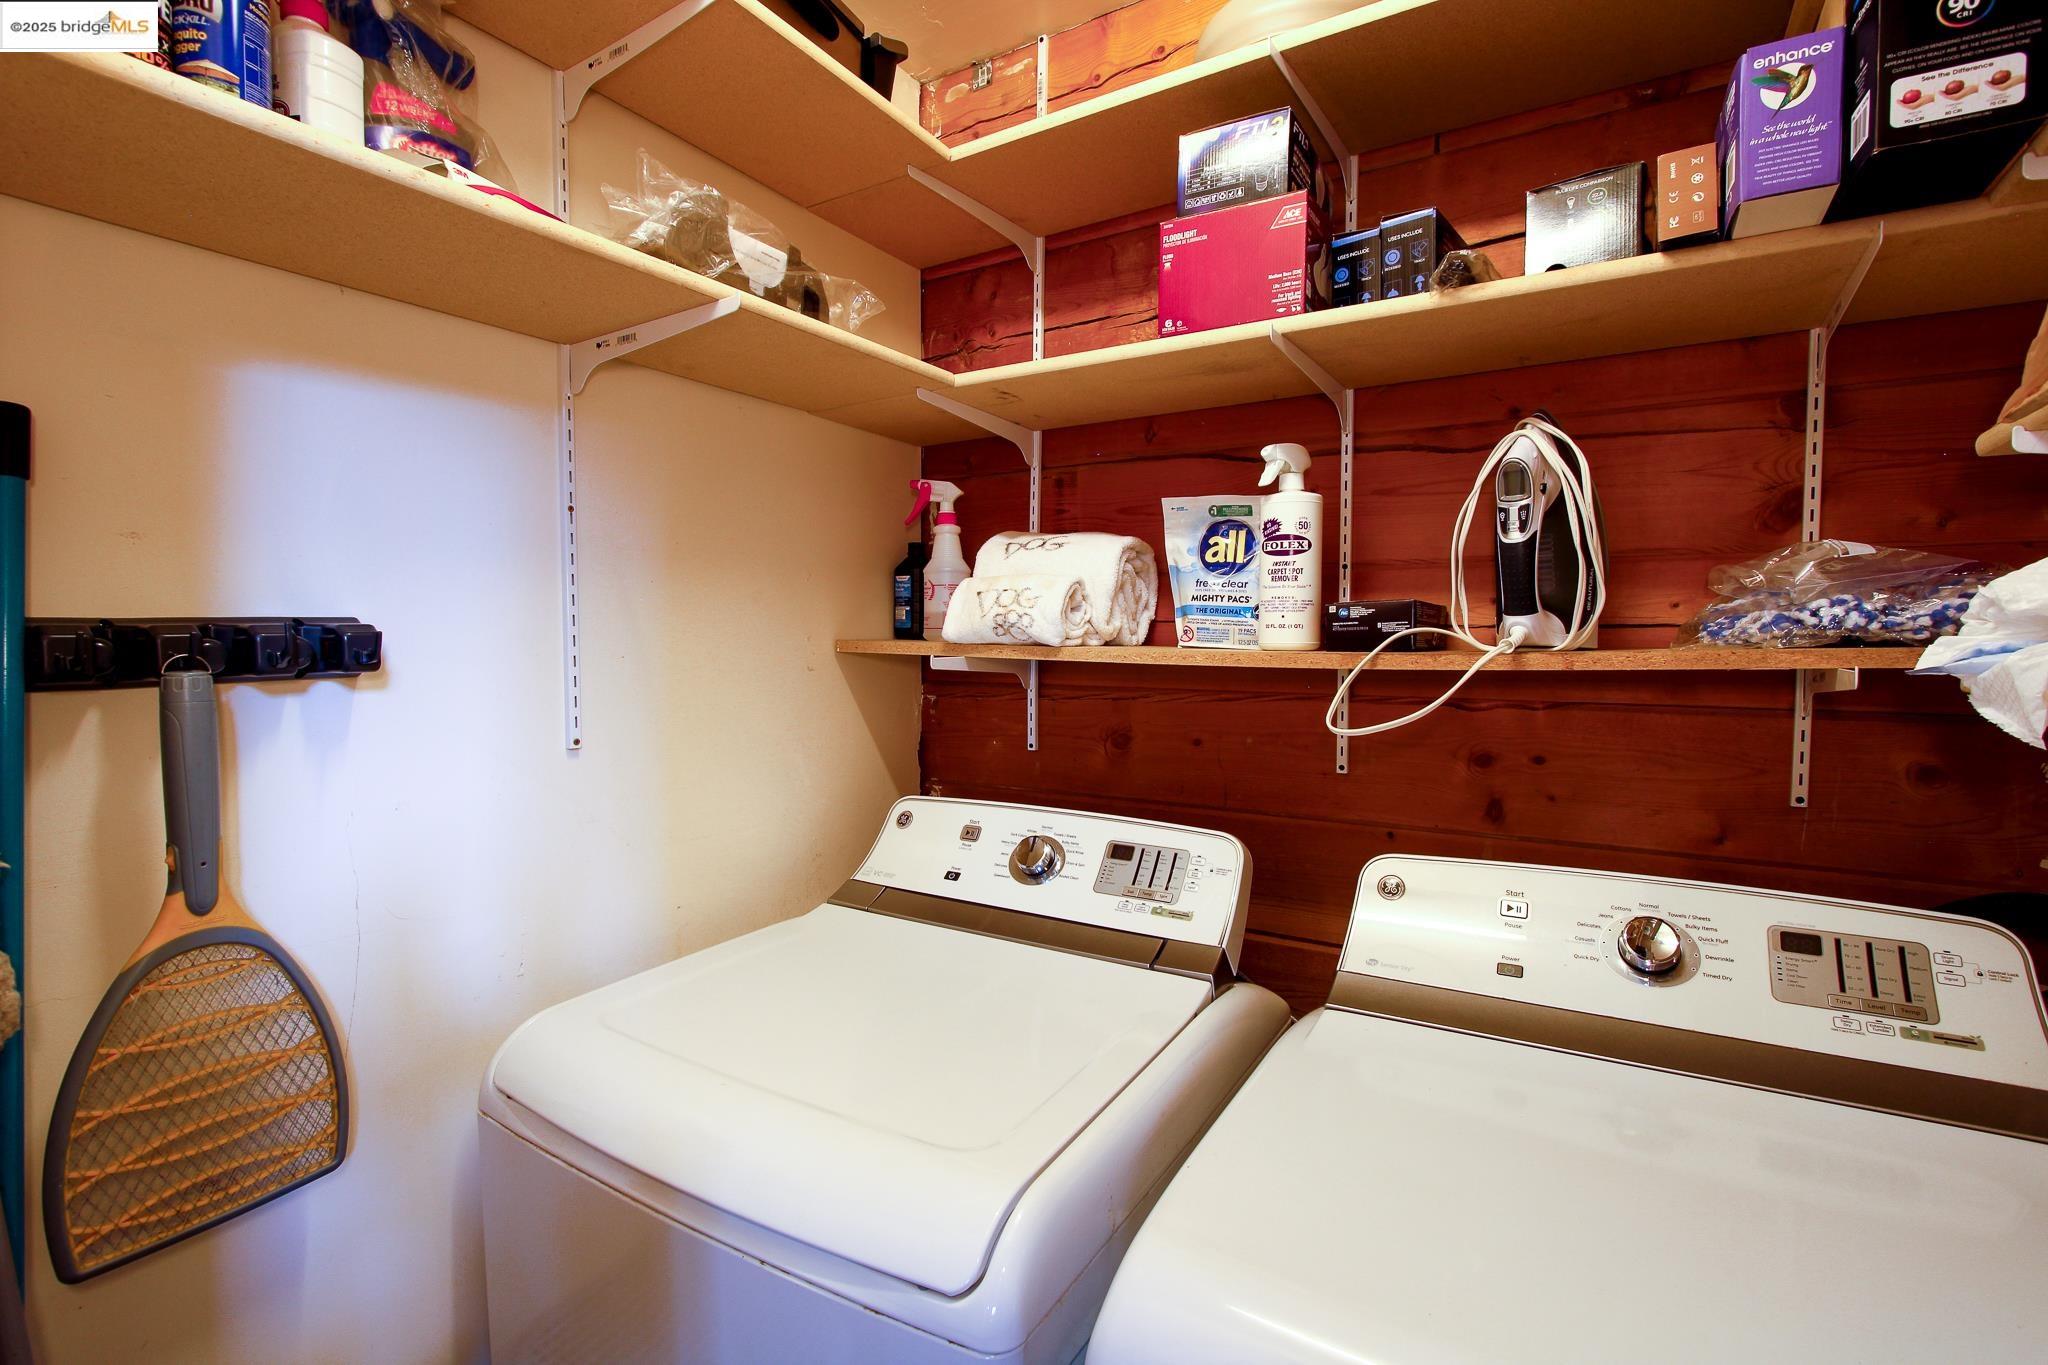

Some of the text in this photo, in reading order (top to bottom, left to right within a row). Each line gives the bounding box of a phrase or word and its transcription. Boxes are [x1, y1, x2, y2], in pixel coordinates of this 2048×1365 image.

[1956, 10, 1973, 18] CRI
[1753, 41, 1834, 70] enhance
[1937, 70, 1951, 78] the
[1952, 61, 1994, 76] Difference
[1762, 114, 1816, 134] See the world
[1765, 130, 1789, 142] whole
[1790, 129, 1807, 137] new
[452, 166, 470, 180] 3M
[1580, 176, 1614, 189] COMPARISON
[1283, 208, 1302, 219] ACE
[1163, 229, 1198, 243] FLOODLIGHT
[1387, 227, 1423, 243] USES INCLUDE
[1337, 247, 1370, 261] USES INCLUDE
[1165, 319, 1173, 328] 6
[1298, 521, 1308, 530] 50
[1003, 536, 1069, 560] DOG
[1204, 529, 1247, 563] all
[1264, 541, 1305, 550] FOLEX
[1267, 568, 1287, 576] CARPET
[1195, 579, 1248, 588] fre clear
[1191, 594, 1226, 603] MIGHTY
[1505, 889, 1525, 898] Start
[1667, 911, 1687, 919] Towels
[1692, 914, 1711, 922] Sheets
[1576, 921, 1602, 929] Delicates
[1685, 923, 1700, 931] Bulky
[1501, 954, 1520, 962] Power
[1705, 954, 1734, 962] Dewrinkle
[1702, 972, 1720, 980] Timed
[1835, 998, 1852, 1006] Time
[1867, 1003, 1886, 1011] Level
[1901, 1007, 1921, 1016] Temp
